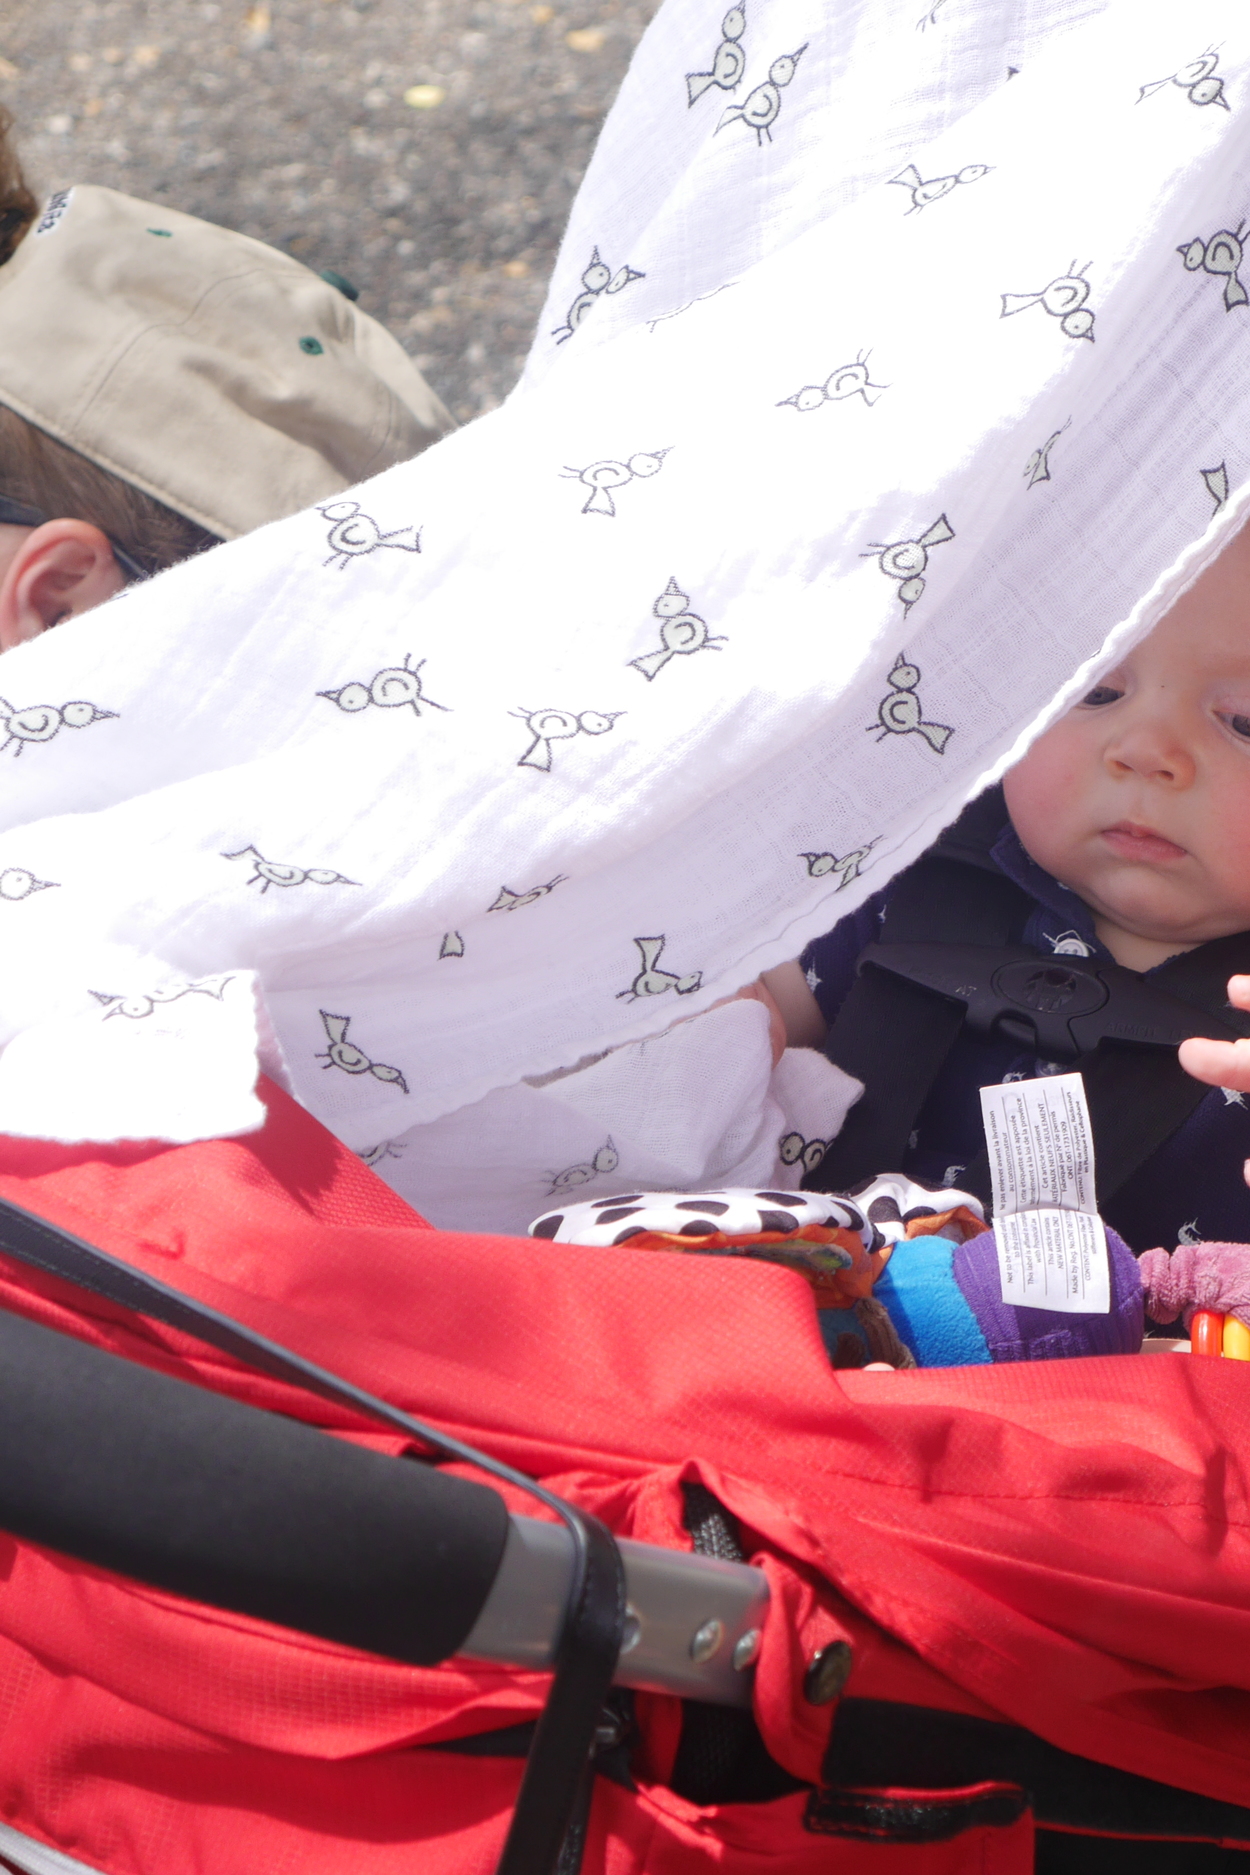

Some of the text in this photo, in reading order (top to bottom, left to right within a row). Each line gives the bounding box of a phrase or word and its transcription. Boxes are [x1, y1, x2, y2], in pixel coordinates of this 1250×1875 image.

[1017, 1098, 1028, 1127] province
[1067, 1092, 1076, 1122] Raidisseurs
[1076, 1101, 1085, 1133] Cellophane
[990, 1111, 998, 1139] livraison
[1010, 1115, 1020, 1143] apposée
[1038, 1104, 1050, 1143] SEULEMENT
[1049, 1111, 1060, 1133] permis
[1023, 1136, 1030, 1145] de
[1034, 1125, 1044, 1153] contient
[1053, 1134, 1060, 1143] de
[1060, 1121, 1072, 1162] 06T-1731909
[1002, 1132, 1015, 1192] au consommateur
[1024, 1146, 1032, 1155] loi
[1046, 1144, 1055, 1167] NEUFS
[1056, 1153, 1065, 1163] par
[1077, 1152, 1082, 1160] de
[1018, 1157, 1026, 1188] étiquette
[1057, 1164, 1067, 1192] Fabriqué
[1020, 1189, 1028, 1203] Cette
[1002, 1232, 1010, 1254] removed
[1023, 1232, 1031, 1249] affixed
[1054, 1228, 1062, 1254] MATERIAL
[1005, 1255, 1012, 1263] be
[1070, 1251, 1078, 1264] Reg.
[1071, 1265, 1078, 1273] by
